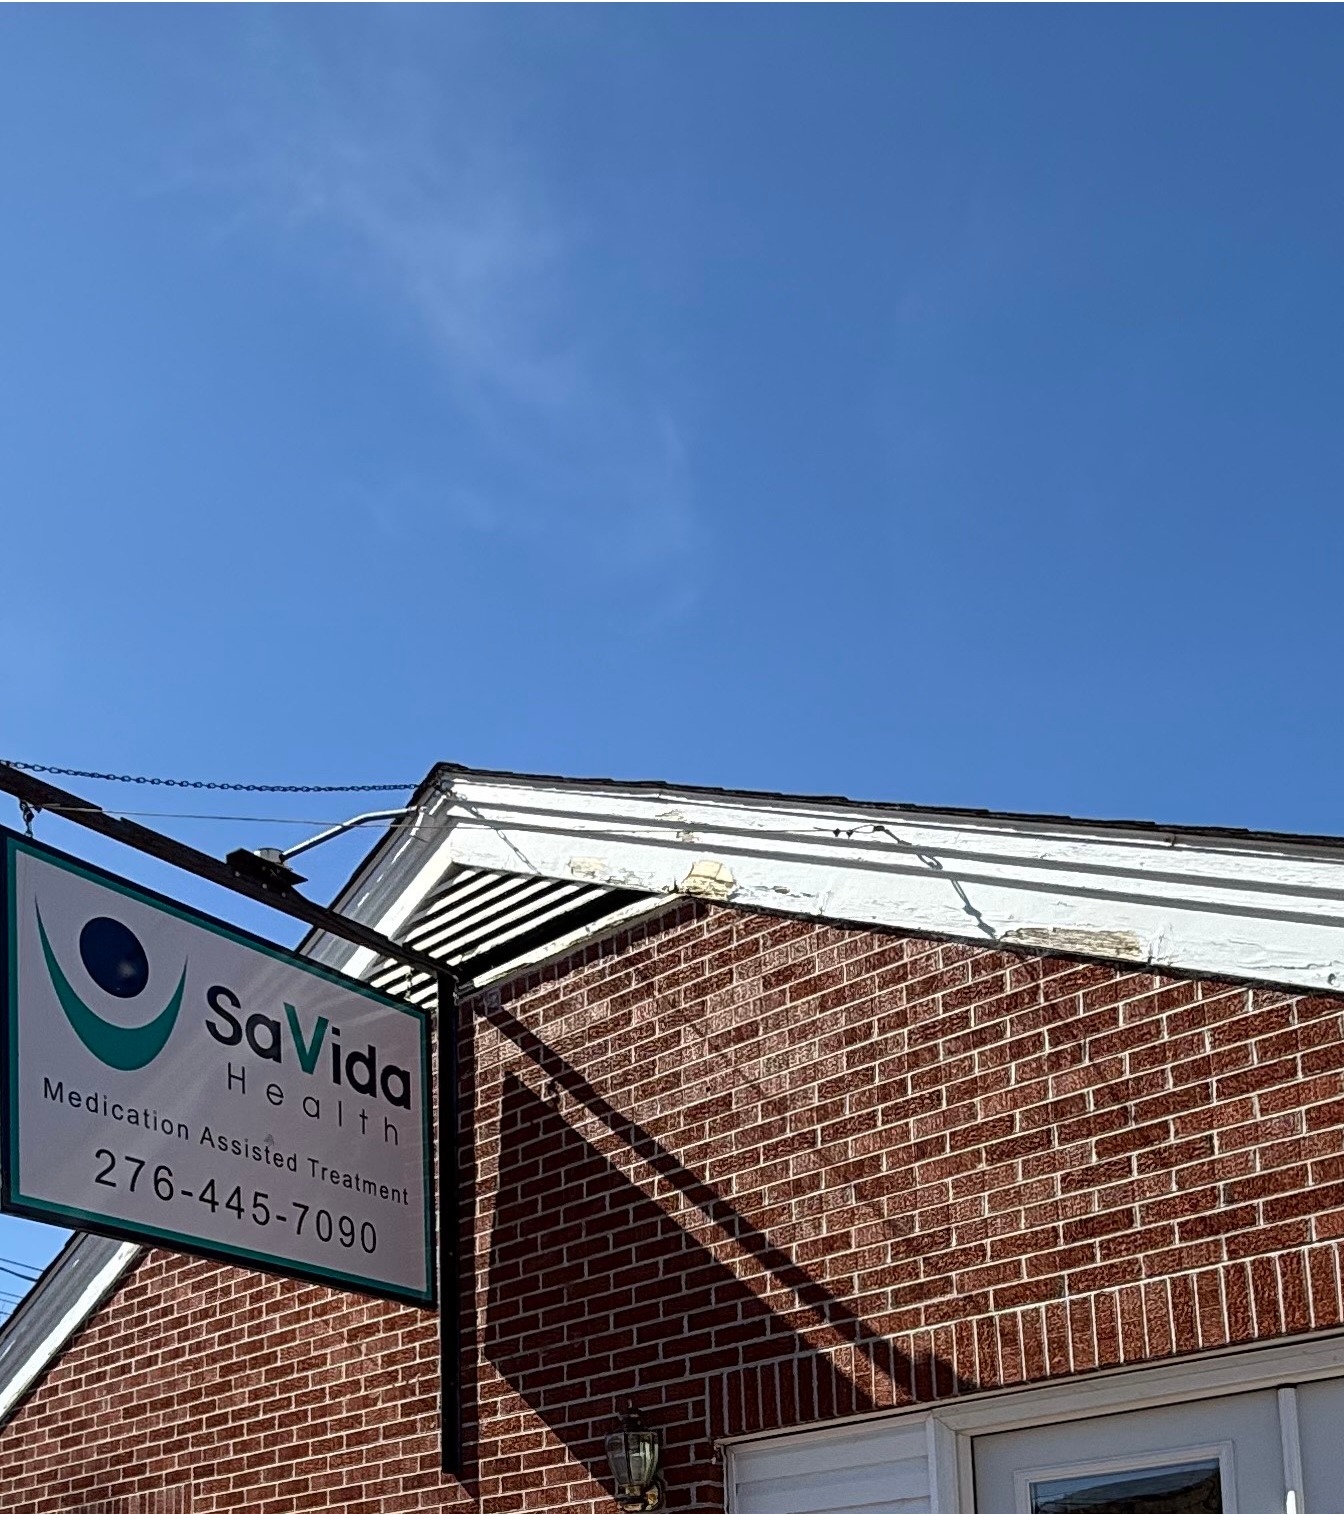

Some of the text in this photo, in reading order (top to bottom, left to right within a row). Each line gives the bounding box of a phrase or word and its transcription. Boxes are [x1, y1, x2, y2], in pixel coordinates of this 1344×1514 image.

[205, 985, 411, 1110] SaVida
[227, 1062, 399, 1145] Health
[44, 1078, 409, 1205] Medication Assisted Treatment
[94, 1149, 377, 1254] 276-445-7090
